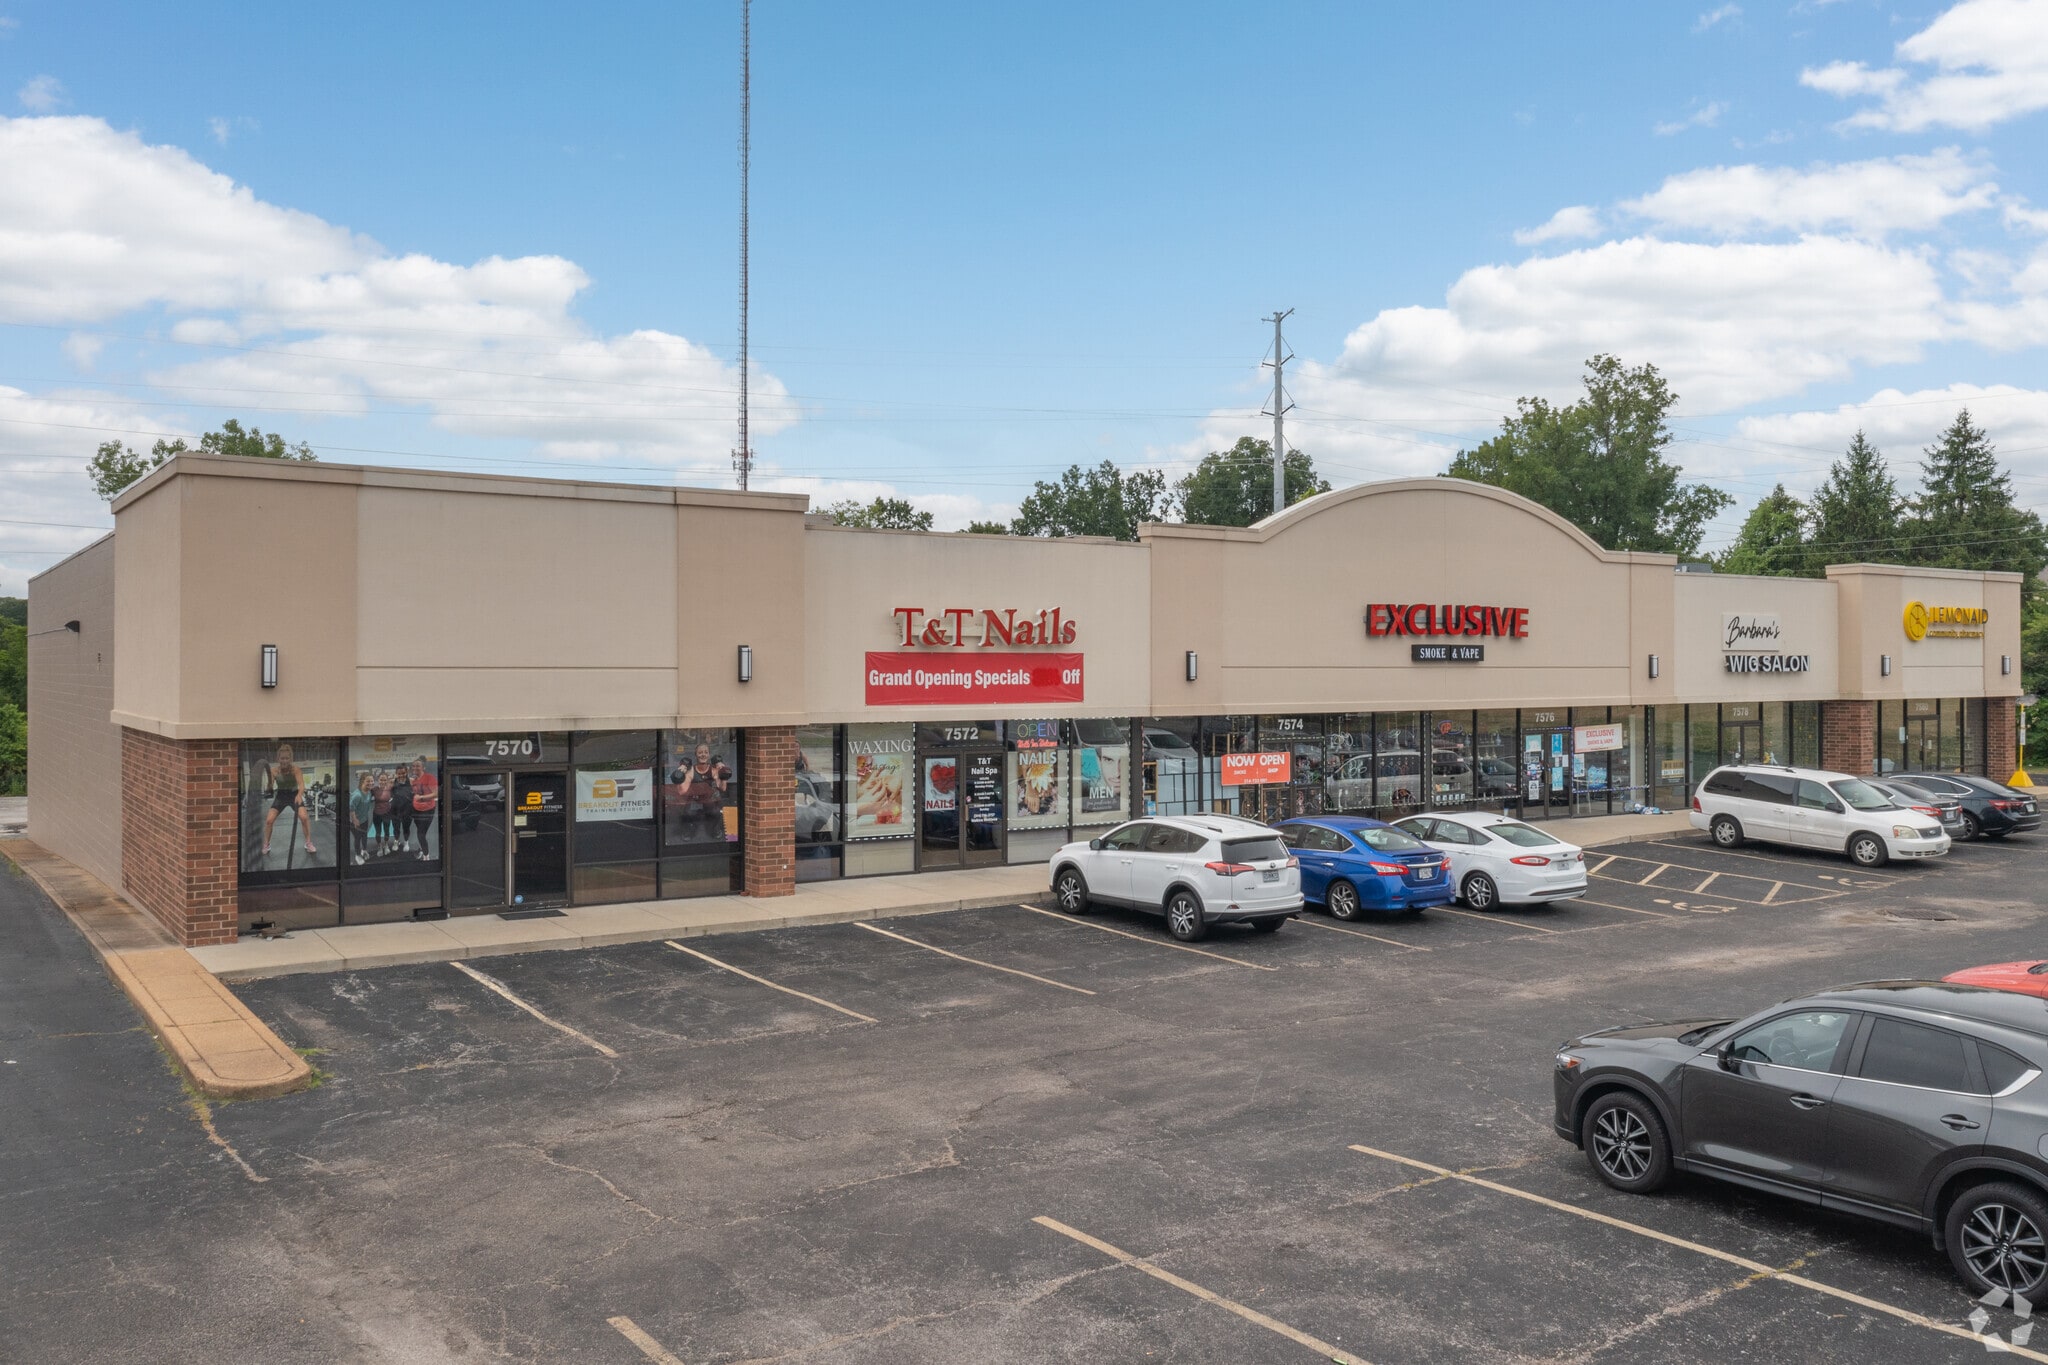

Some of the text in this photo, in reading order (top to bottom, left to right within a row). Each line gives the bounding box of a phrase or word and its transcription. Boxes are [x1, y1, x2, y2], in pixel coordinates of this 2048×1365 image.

[1367, 604, 1529, 637] EXCLUSIVE
[1930, 607, 1988, 624] LEMONAID
[892, 607, 1077, 646] T&T Nails
[1725, 616, 1780, 648] Barbara's
[1419, 647, 1480, 659] SMOKE & VAPE
[1728, 655, 1810, 672] WIG SALON
[869, 669, 1081, 689] Grand Opening Specials Off
[1277, 719, 1304, 730] 7574
[1535, 713, 1555, 722] 7576
[944, 727, 979, 741] 7572
[1017, 722, 1057, 738] OPEN
[485, 739, 533, 756] 7570
[848, 739, 912, 754] WAXING
[977, 757, 992, 765] T&T
[1019, 751, 1058, 766] NAILS
[1226, 754, 1285, 767] NOW OPEN
[985, 767, 998, 775] Spa
[592, 778, 636, 799] BF
[1089, 786, 1114, 799] MEN
[526, 791, 554, 805] BF
[578, 799, 651, 809] BREAKOUT FITNESS
[926, 799, 955, 810] NAILS
